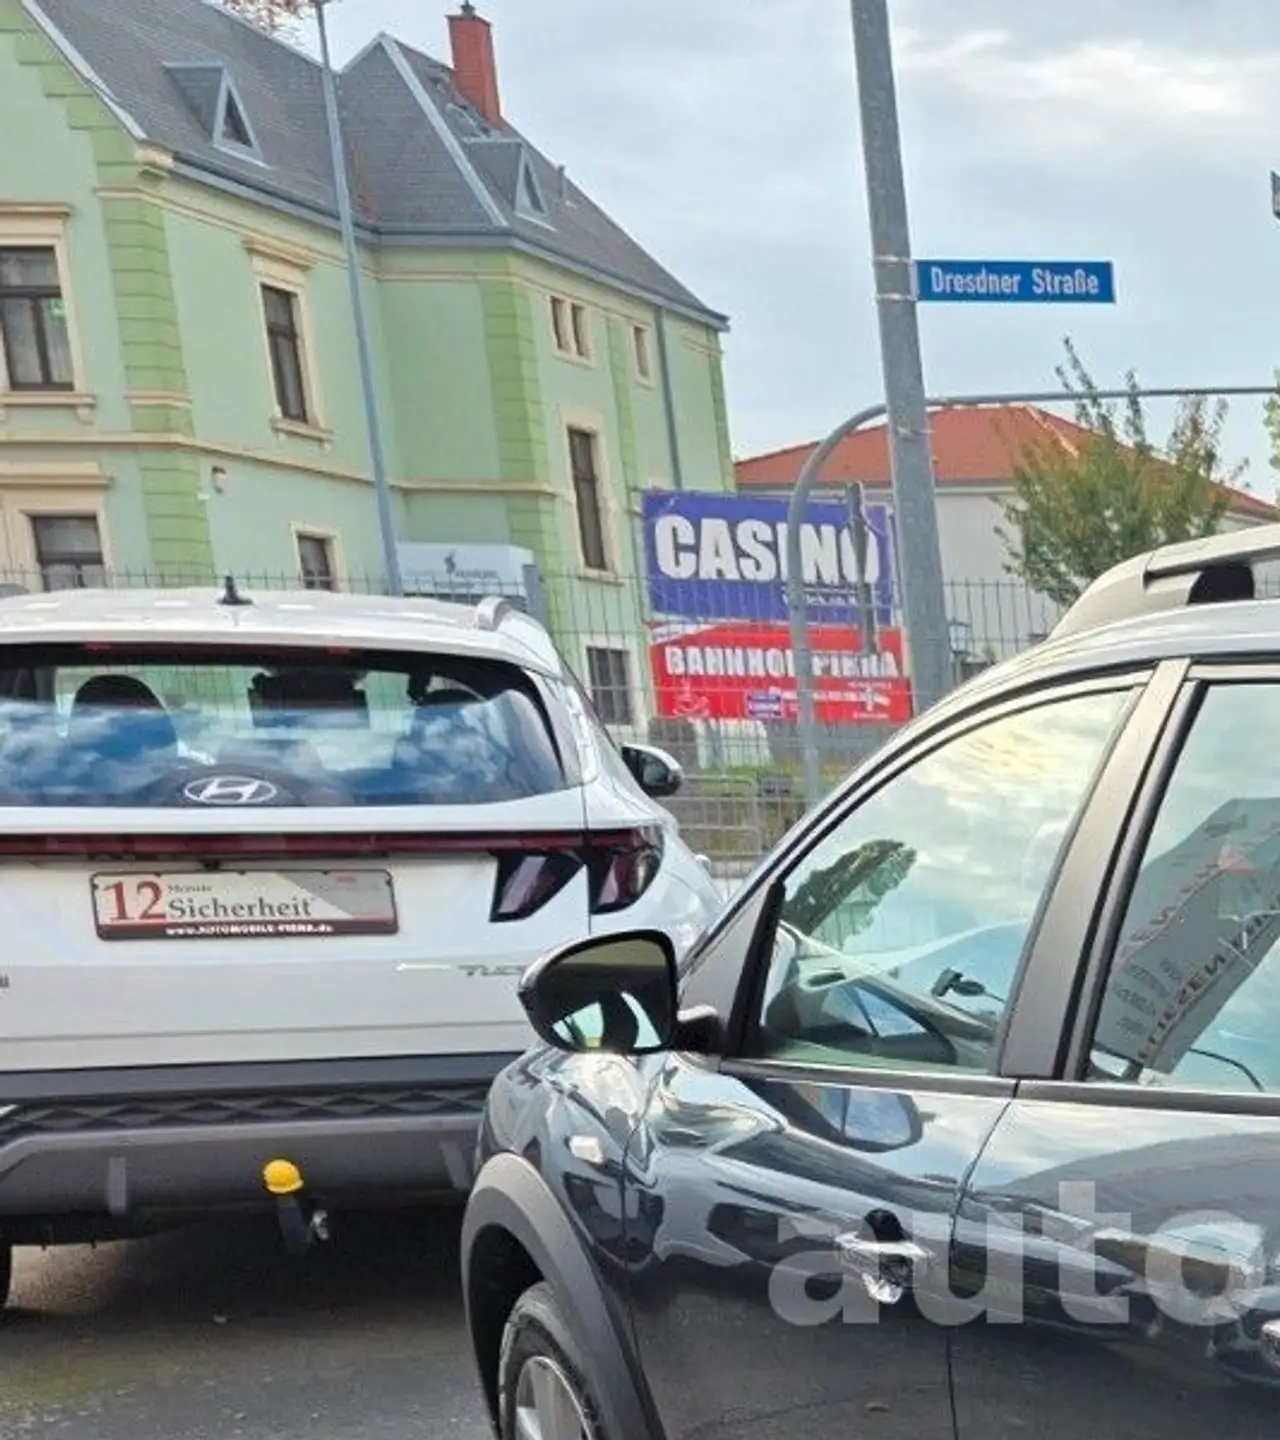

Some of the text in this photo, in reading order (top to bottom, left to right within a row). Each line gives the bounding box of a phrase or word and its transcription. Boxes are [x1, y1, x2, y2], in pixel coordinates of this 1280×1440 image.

[930, 264, 1099, 296] Dresdner Straße
[664, 646, 801, 679] BAHNHO
[102, 880, 167, 921] 12
[167, 897, 313, 920] Sicherheit
